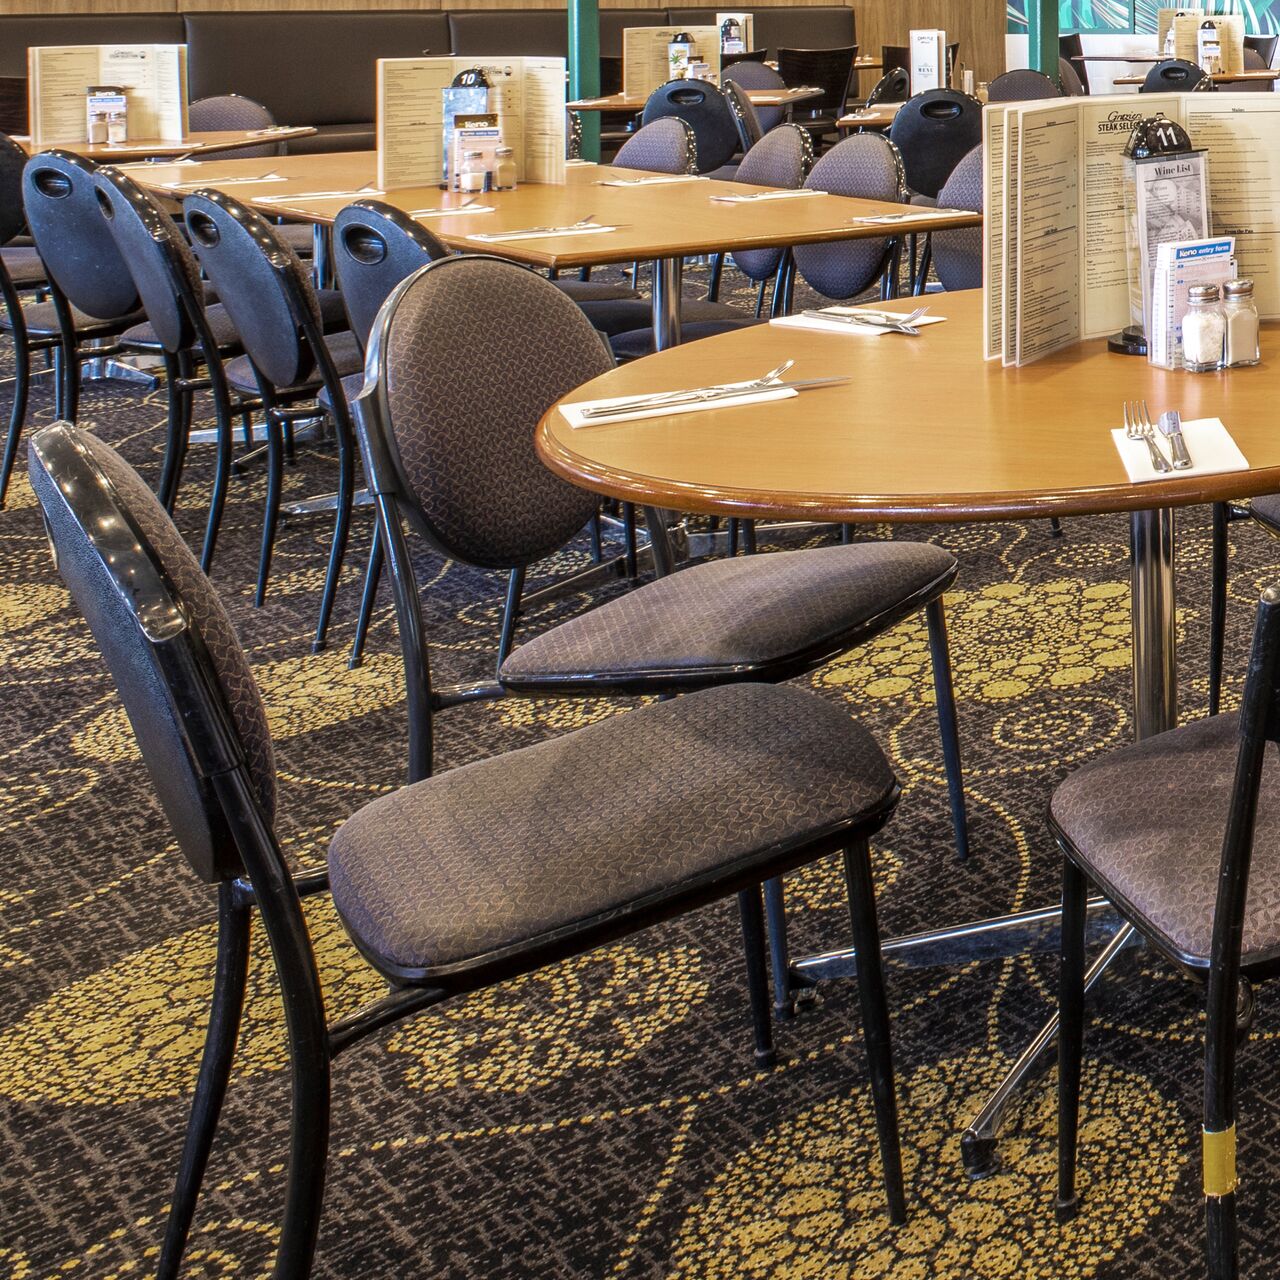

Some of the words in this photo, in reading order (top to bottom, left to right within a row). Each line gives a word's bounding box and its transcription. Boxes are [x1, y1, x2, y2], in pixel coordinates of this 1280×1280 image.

[460, 73, 475, 85] 10
[1098, 122, 1119, 132] STEAK
[1119, 121, 1140, 131] SELEC
[1156, 126, 1179, 147] 11
[1154, 166, 1176, 176] Wine
[1176, 164, 1191, 173] List
[1198, 247, 1214, 255] entry
[1215, 244, 1230, 252] form
